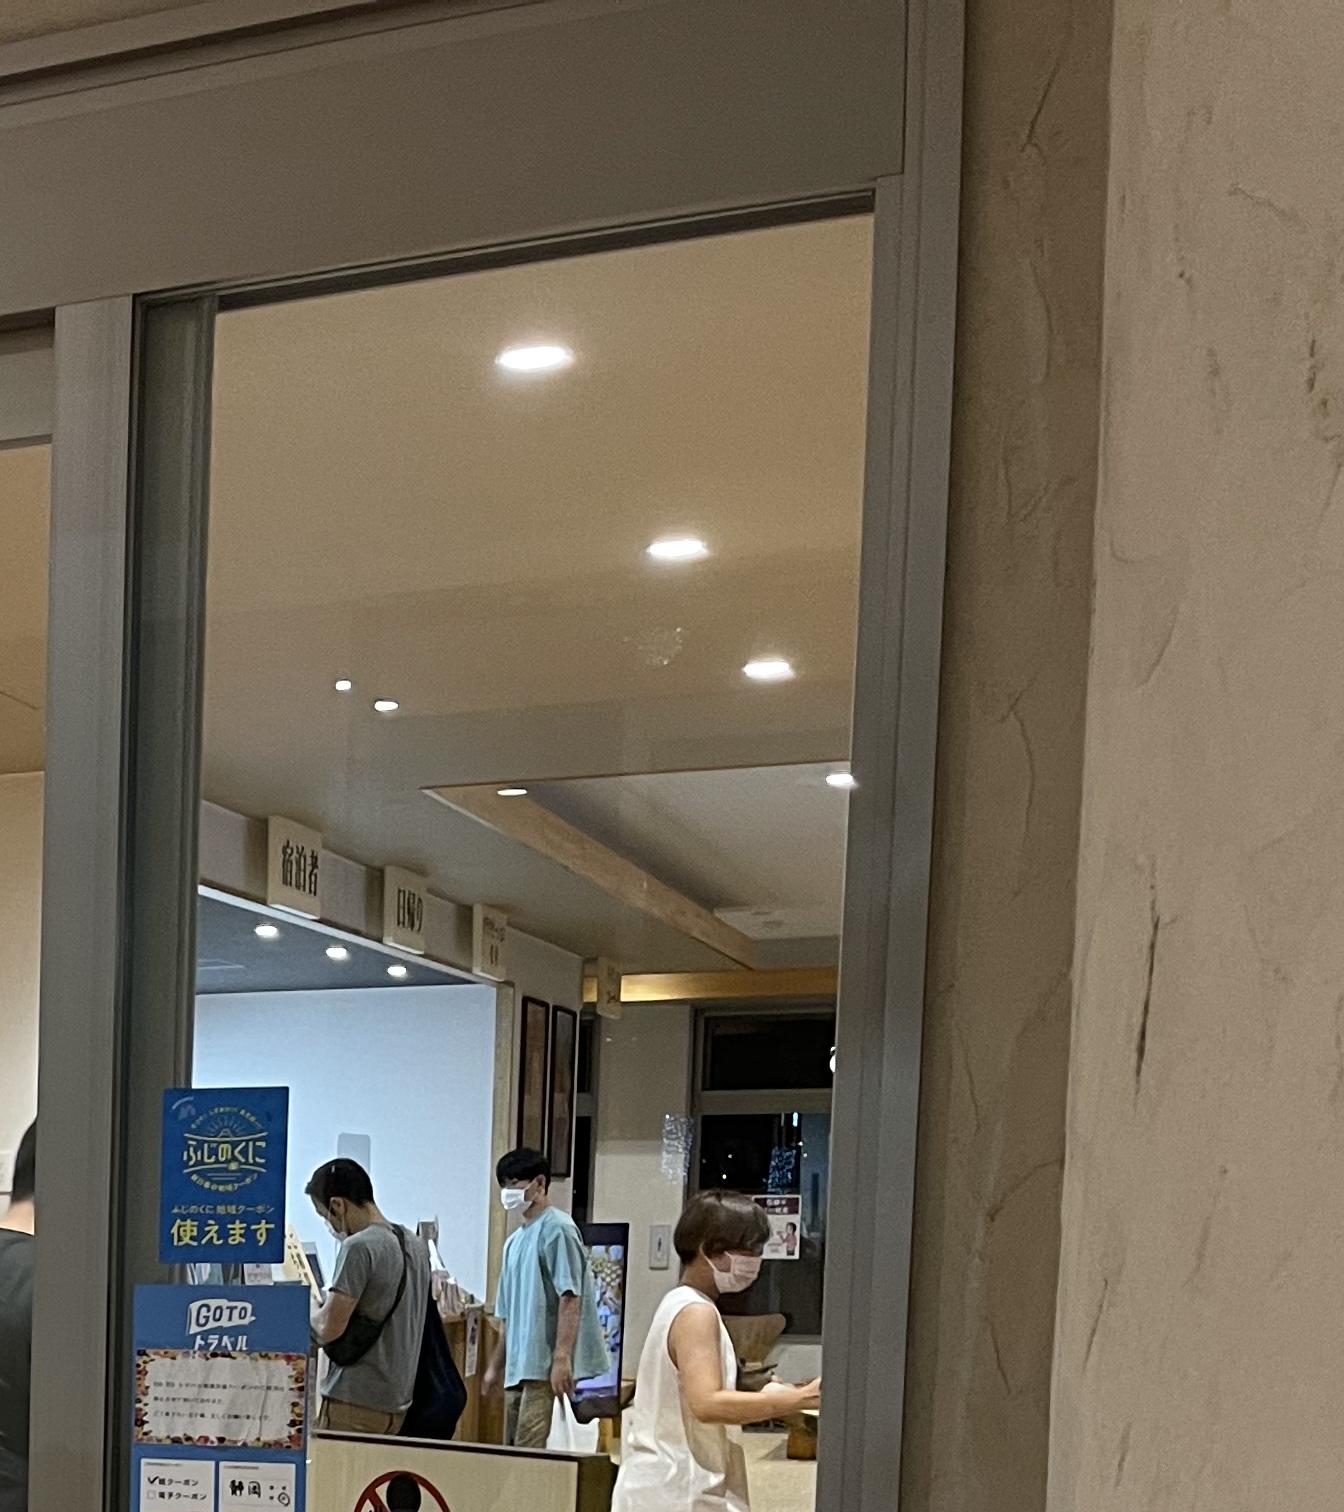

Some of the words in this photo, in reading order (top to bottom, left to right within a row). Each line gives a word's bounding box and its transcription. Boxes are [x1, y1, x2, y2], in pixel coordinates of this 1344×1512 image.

[183, 1141, 266, 1166] ふじのくに
[170, 1219, 275, 1246] 使えます
[194, 1335, 248, 1351] トラベル
